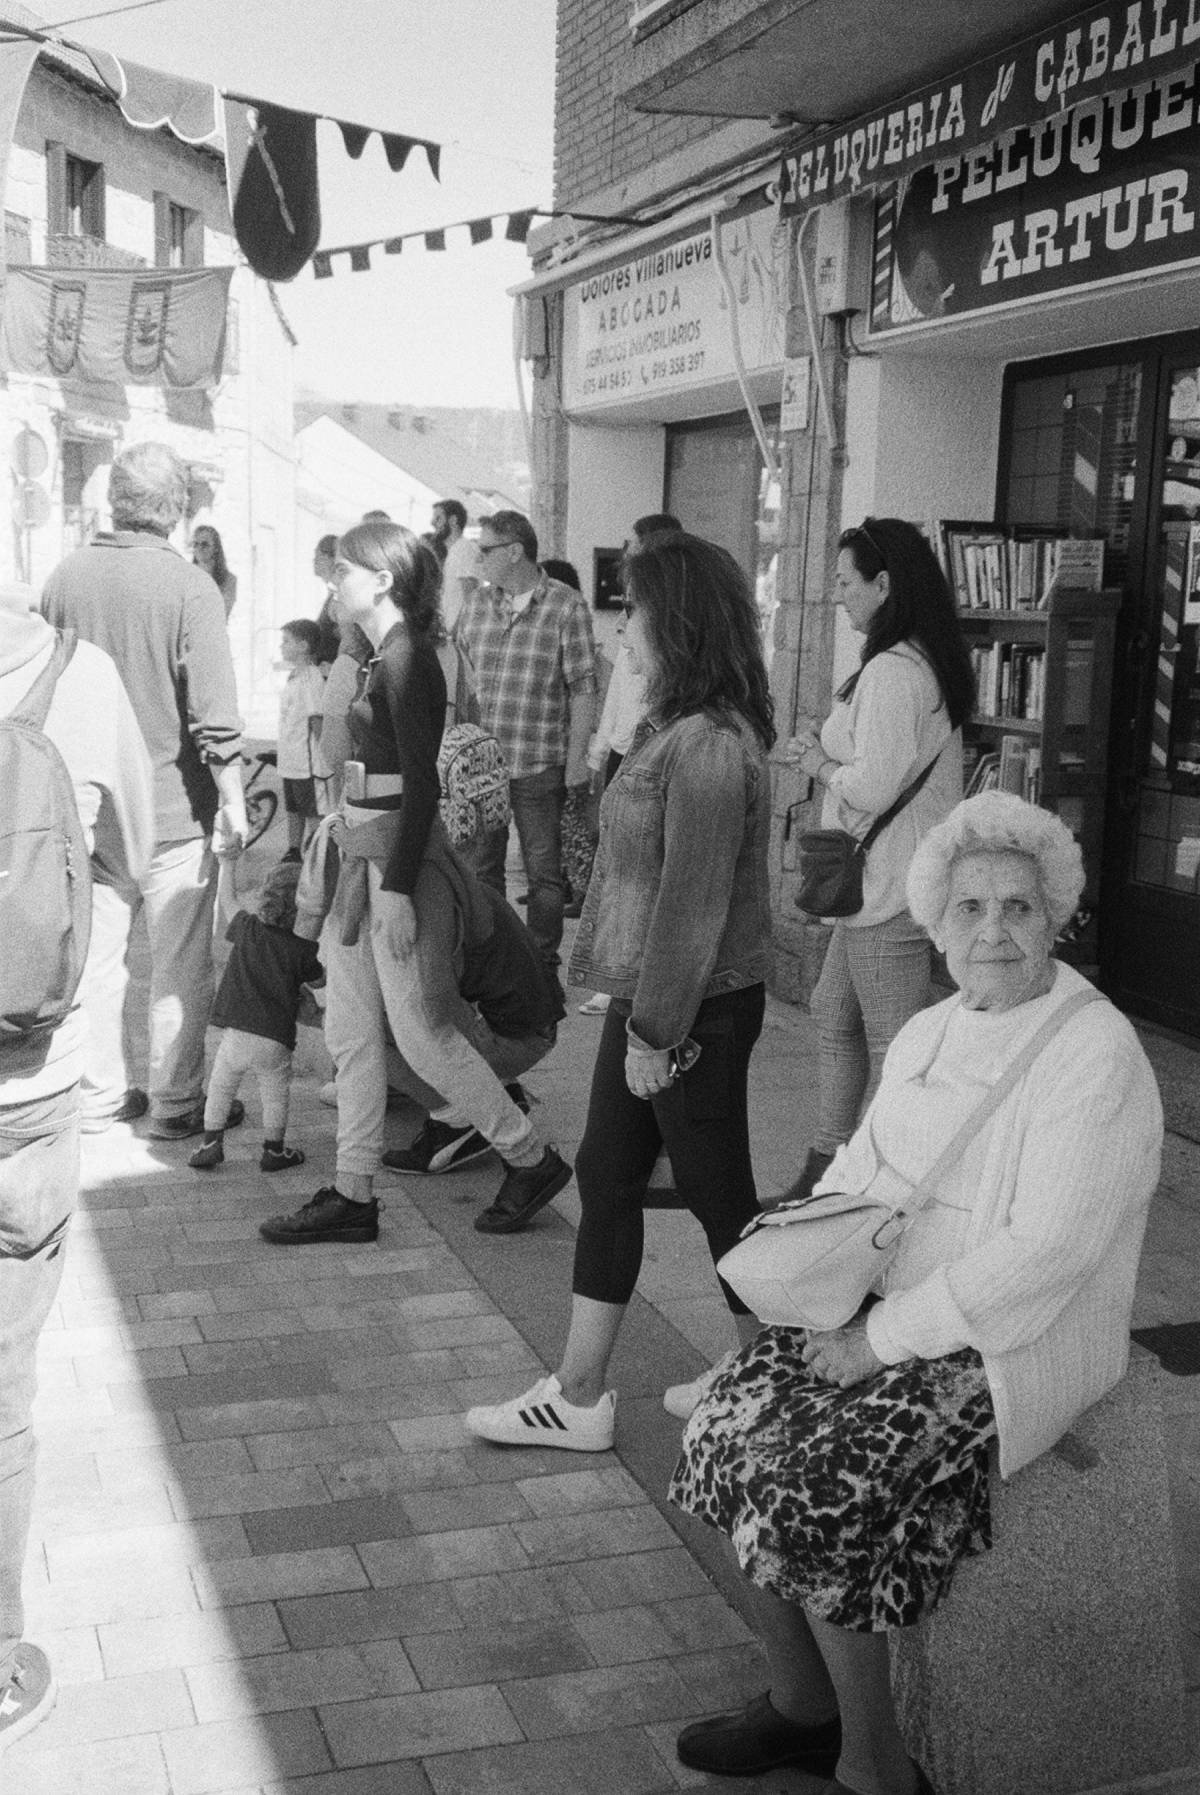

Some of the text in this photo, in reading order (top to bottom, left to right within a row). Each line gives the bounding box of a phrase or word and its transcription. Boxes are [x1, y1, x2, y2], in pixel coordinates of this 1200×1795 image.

[783, 83, 966, 204] PELUQUERIA
[931, 63, 1200, 214] PELUQUE
[635, 235, 712, 284] Villanueva
[980, 168, 1195, 286] ARTUR
